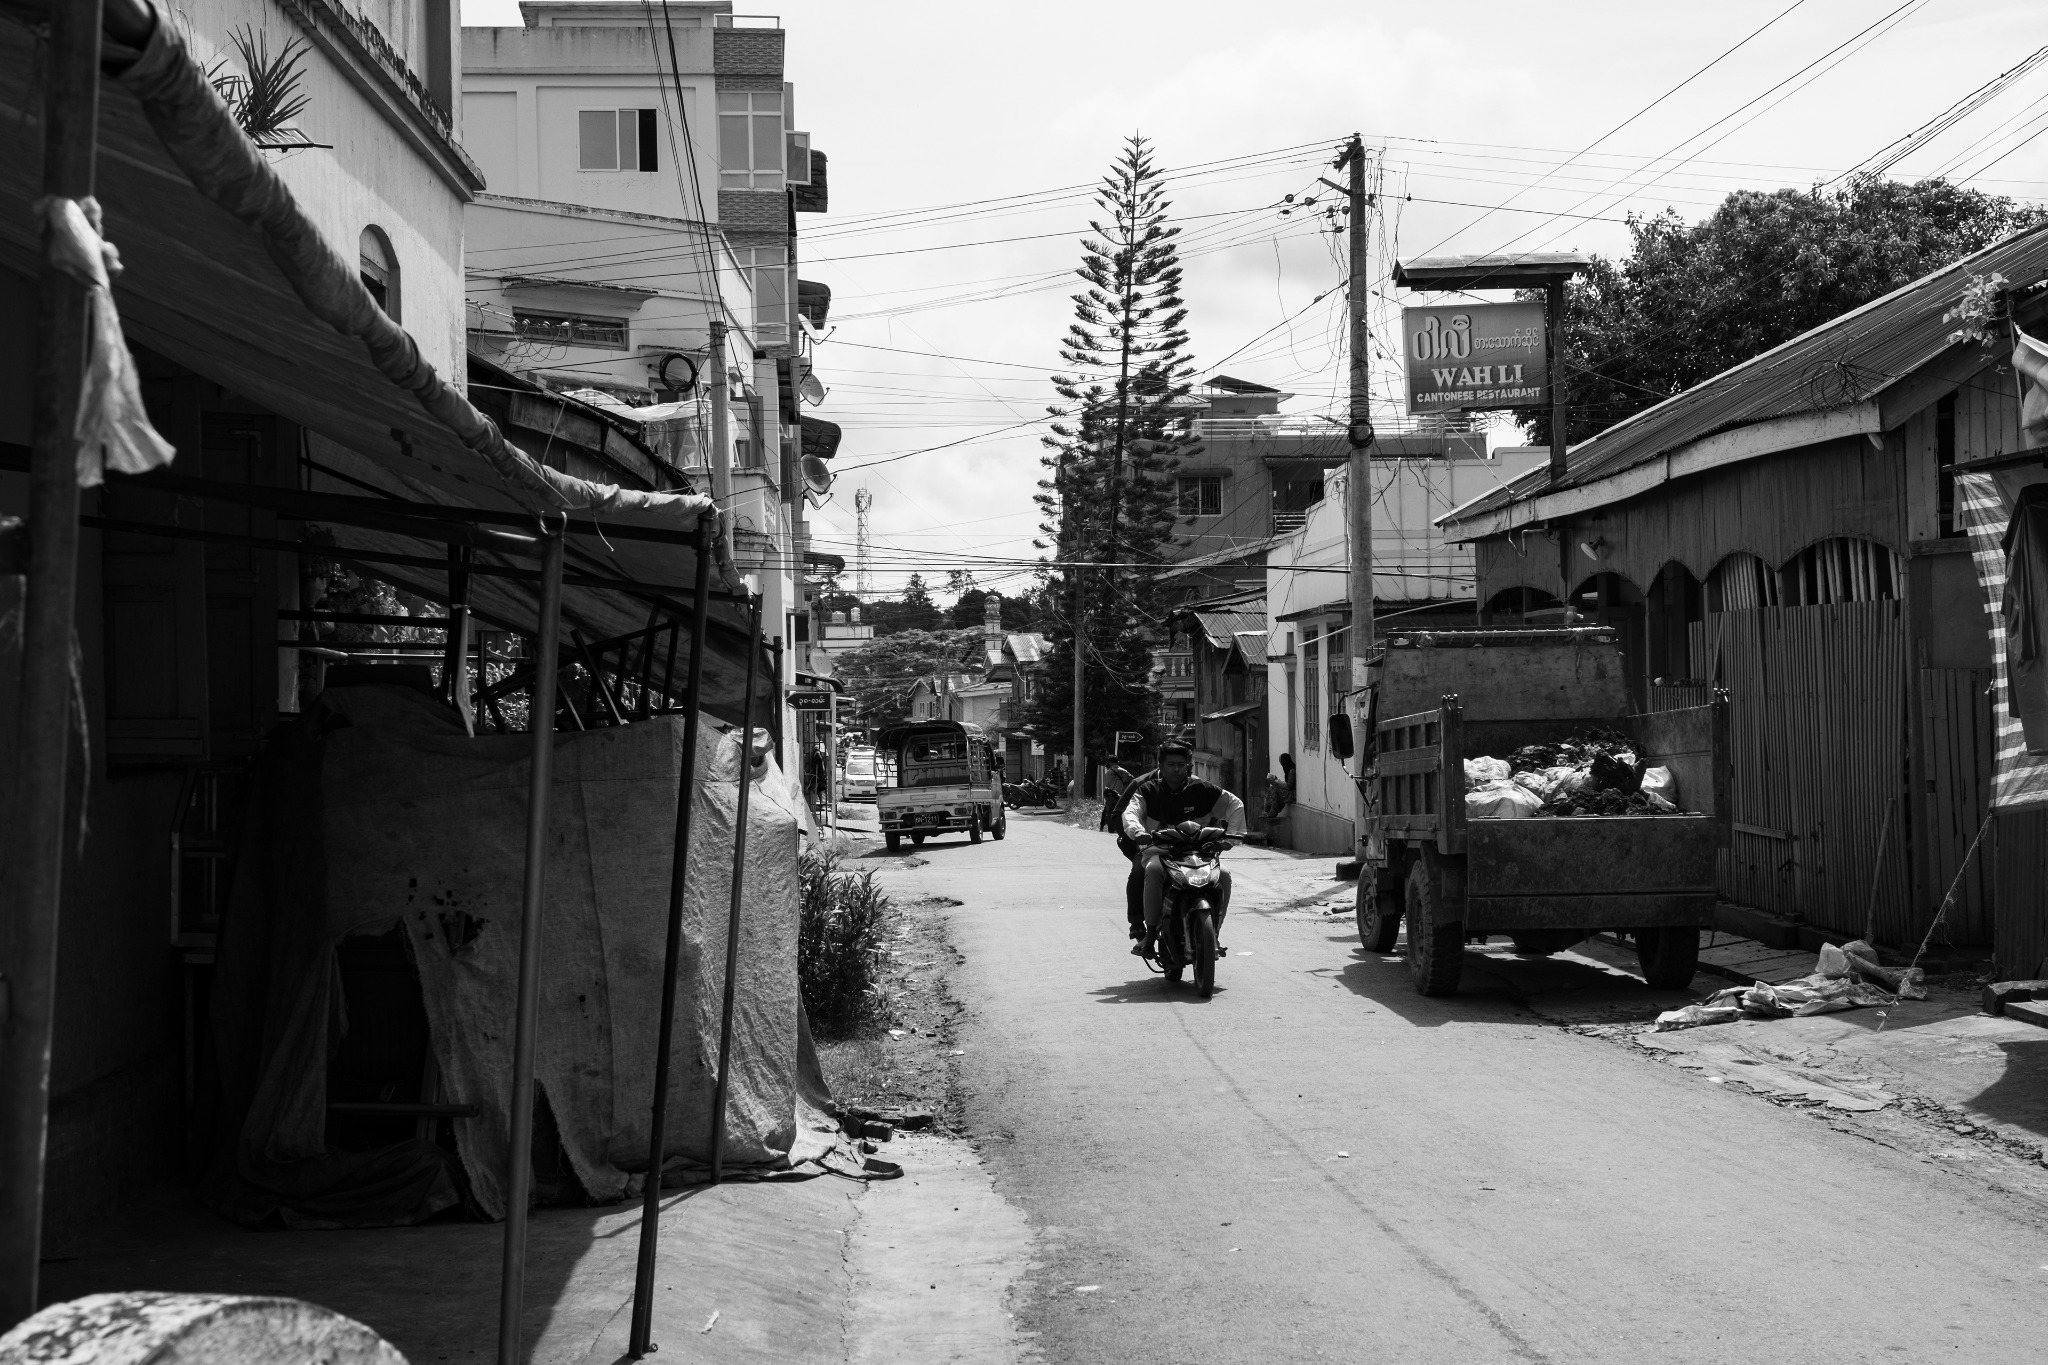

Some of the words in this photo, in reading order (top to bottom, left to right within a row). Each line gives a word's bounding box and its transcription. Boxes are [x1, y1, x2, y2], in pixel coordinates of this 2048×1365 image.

[1474, 327, 1539, 354] စားသောက်ဆိုင်
[1431, 366, 1492, 387] WAH
[1498, 364, 1523, 384] LI
[1417, 390, 1474, 403] CANTONESE
[1476, 387, 1541, 400] RESTAURANT
